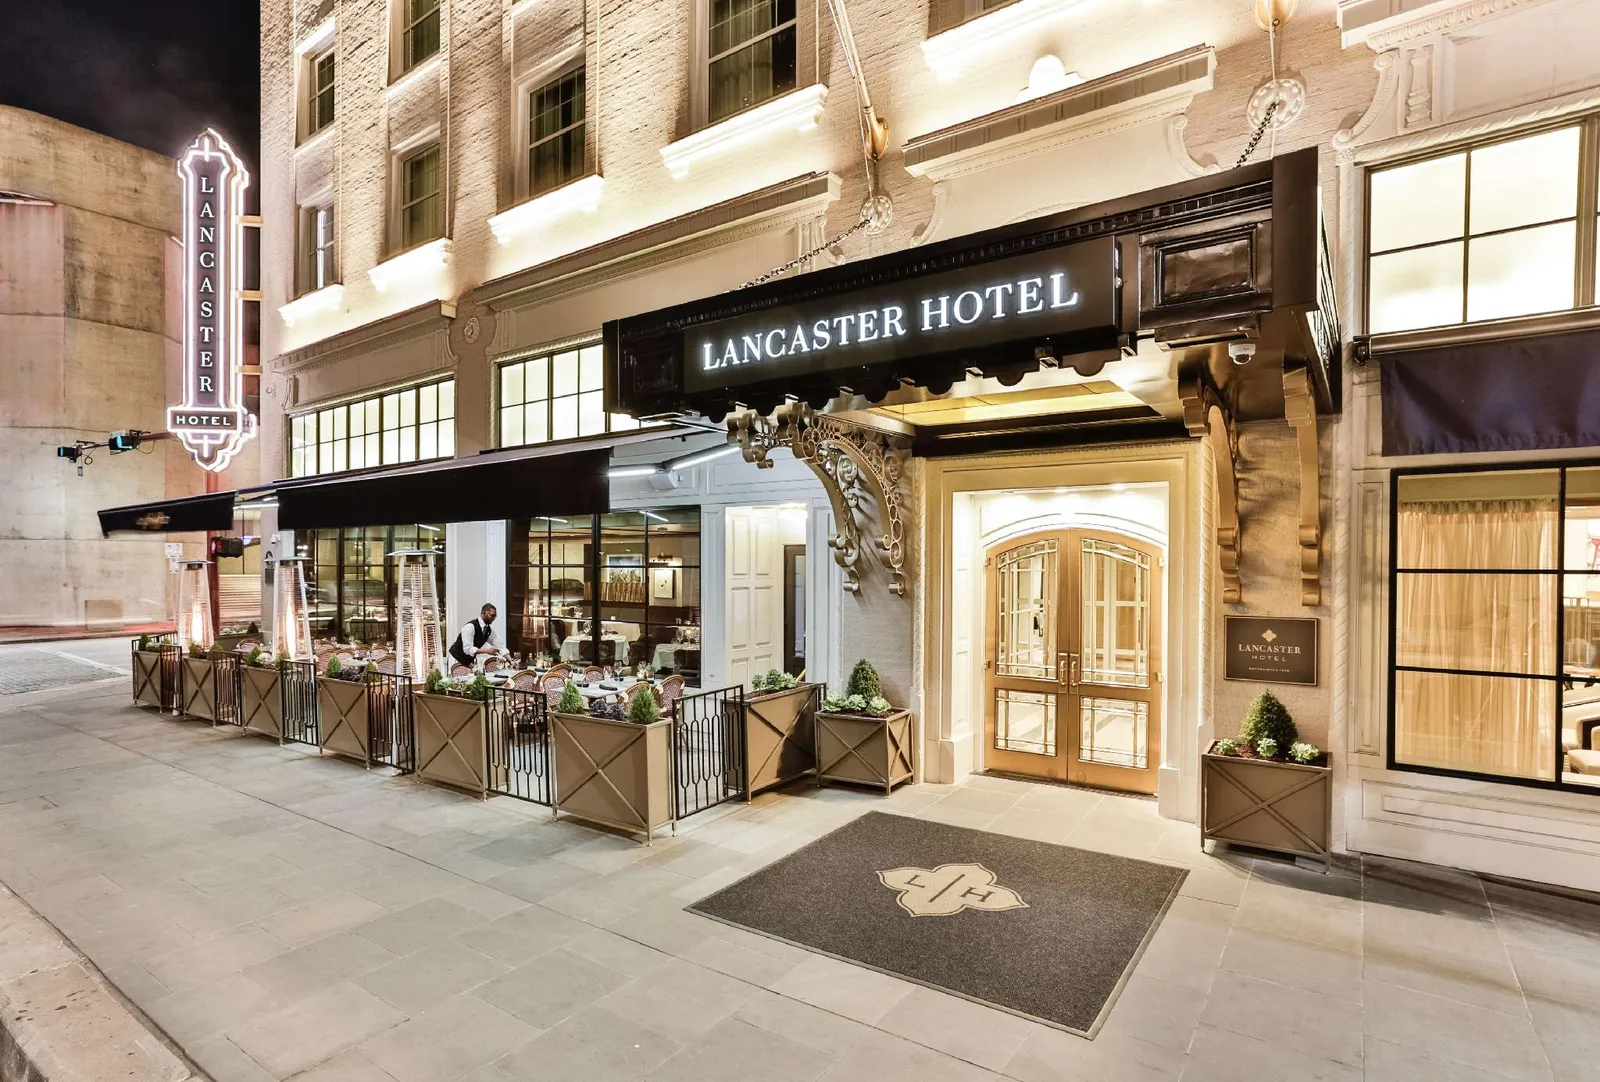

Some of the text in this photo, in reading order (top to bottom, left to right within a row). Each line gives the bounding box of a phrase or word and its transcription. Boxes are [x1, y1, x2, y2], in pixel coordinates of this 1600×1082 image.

[199, 176, 215, 393] LANCASTER
[703, 272, 1080, 371] LANCASTER HOTEL
[176, 415, 231, 426] HOTEL
[1238, 643, 1301, 654] LANCASTER
